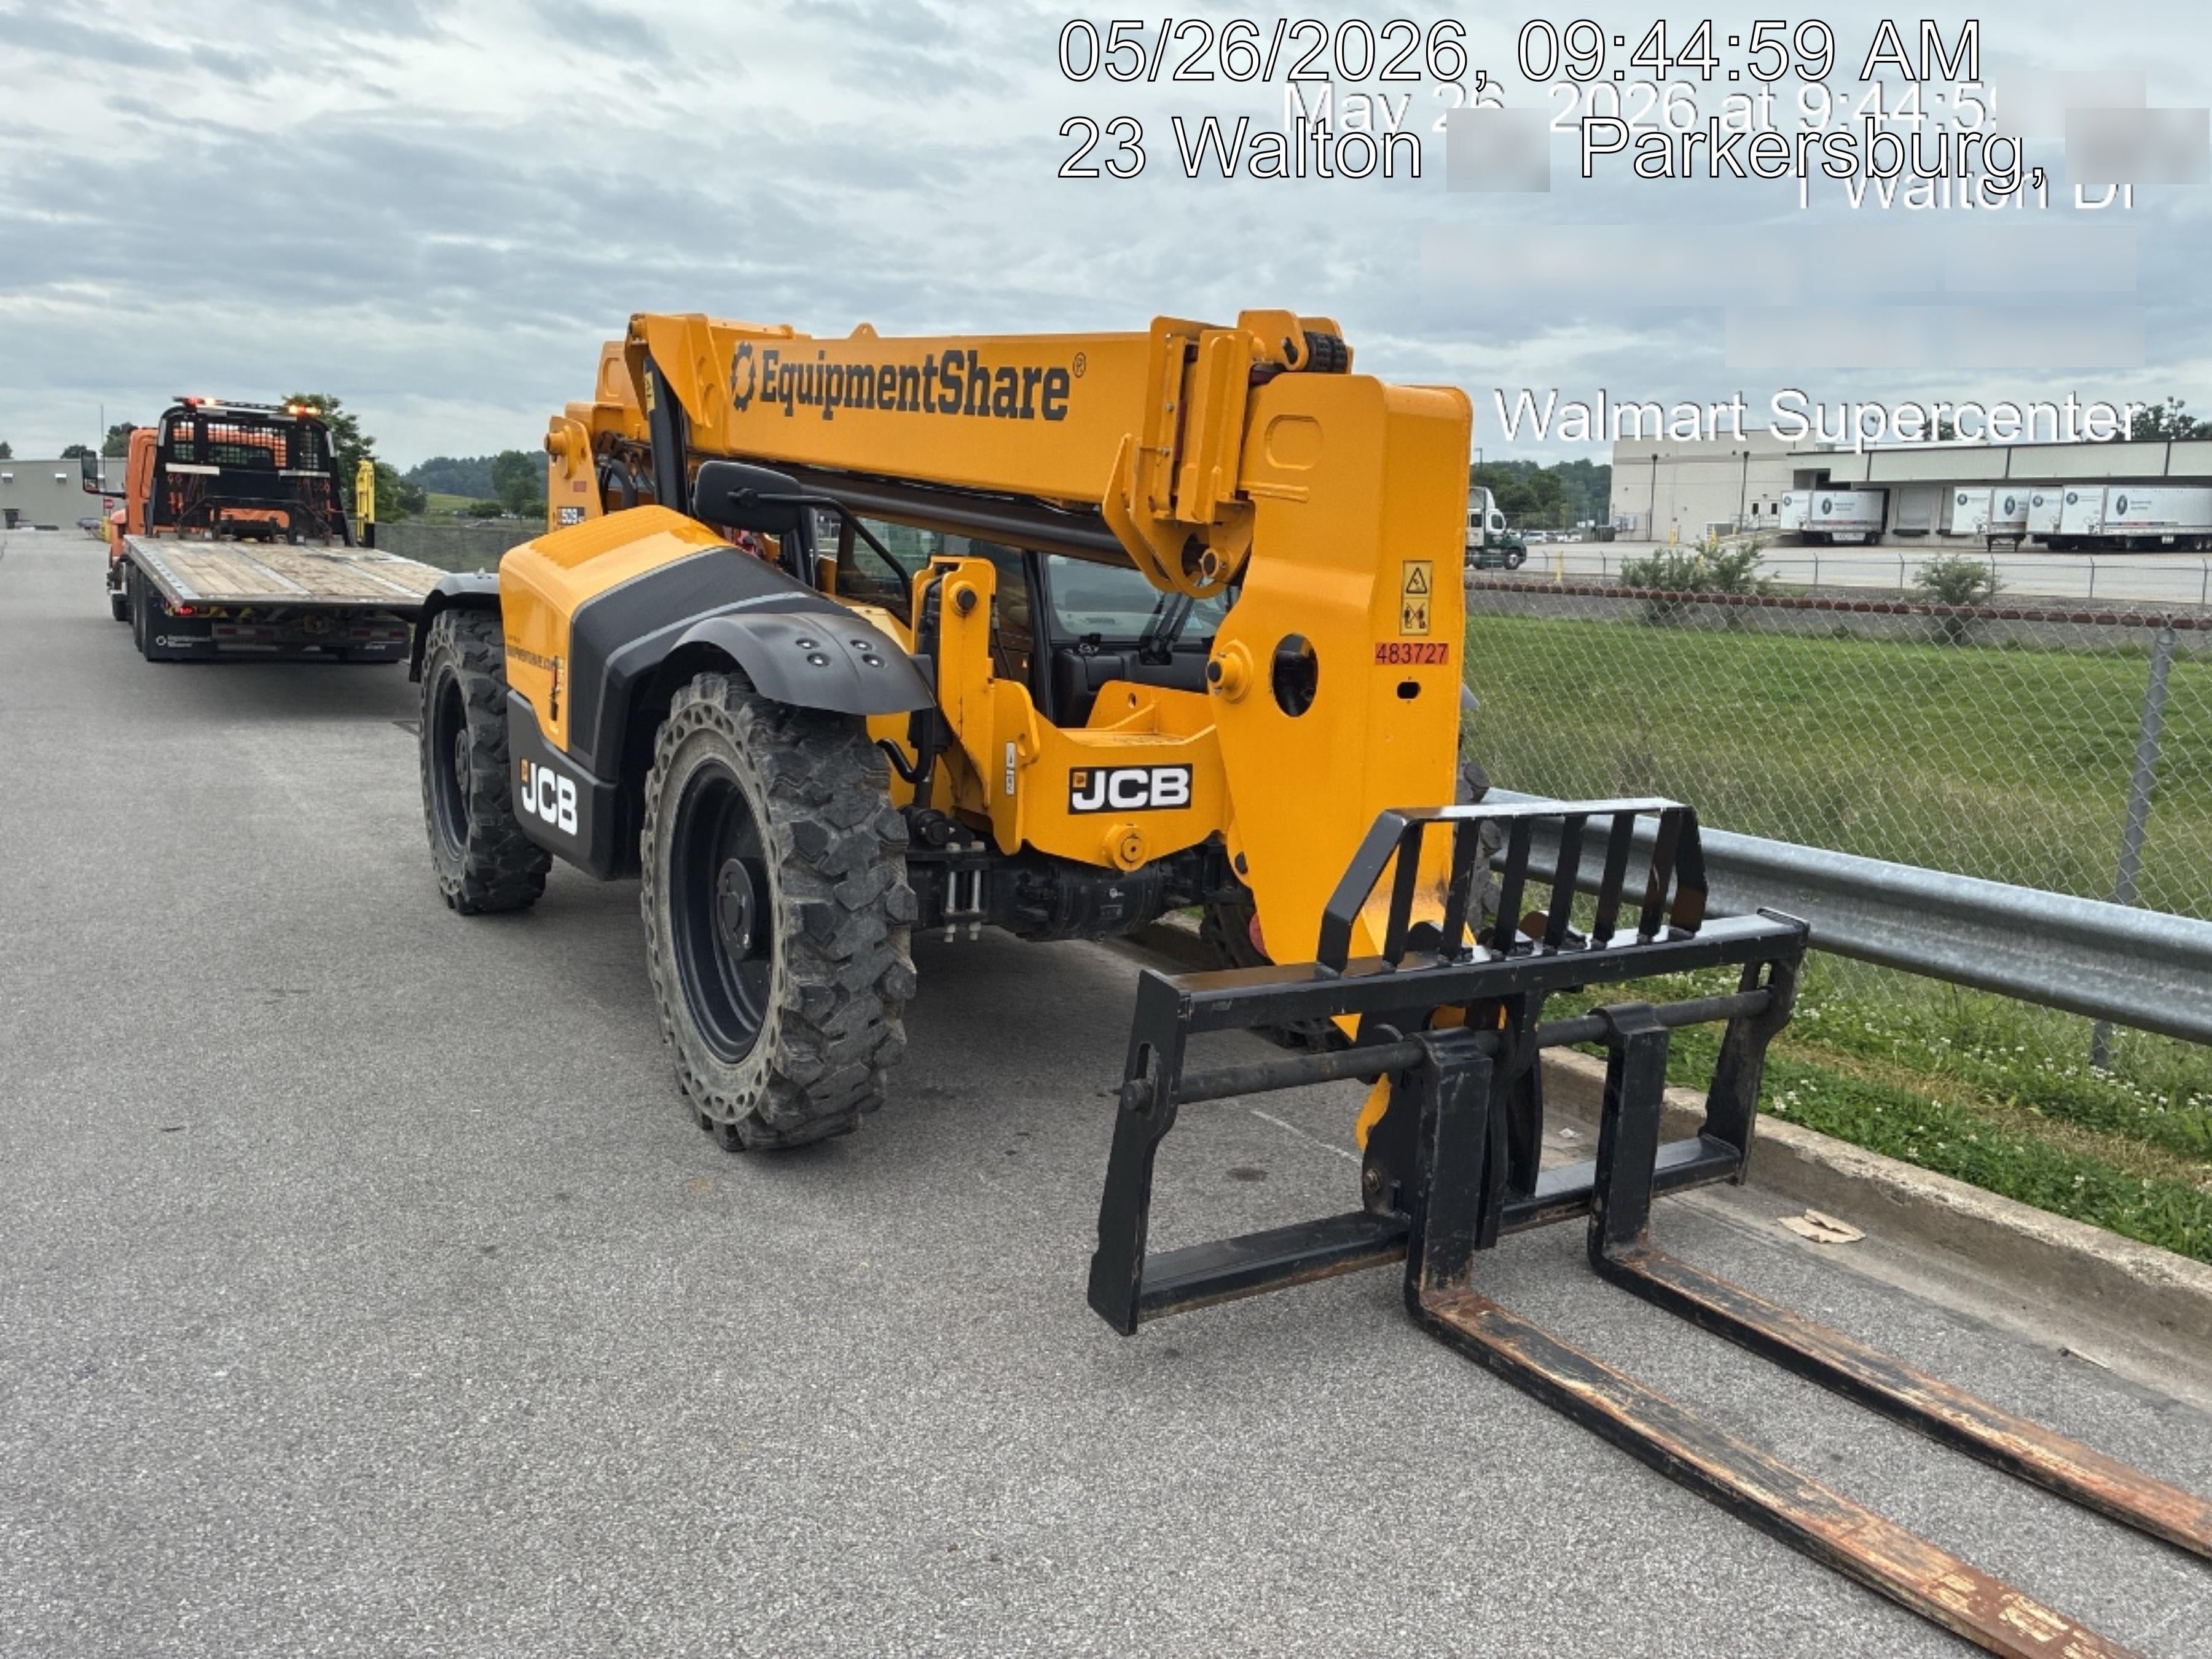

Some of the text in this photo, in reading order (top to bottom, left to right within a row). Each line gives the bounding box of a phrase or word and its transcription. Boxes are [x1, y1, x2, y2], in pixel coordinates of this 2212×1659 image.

[1376, 643, 1448, 665] 483727
[520, 762, 578, 836] JCB
[1072, 767, 1190, 811] JCB
